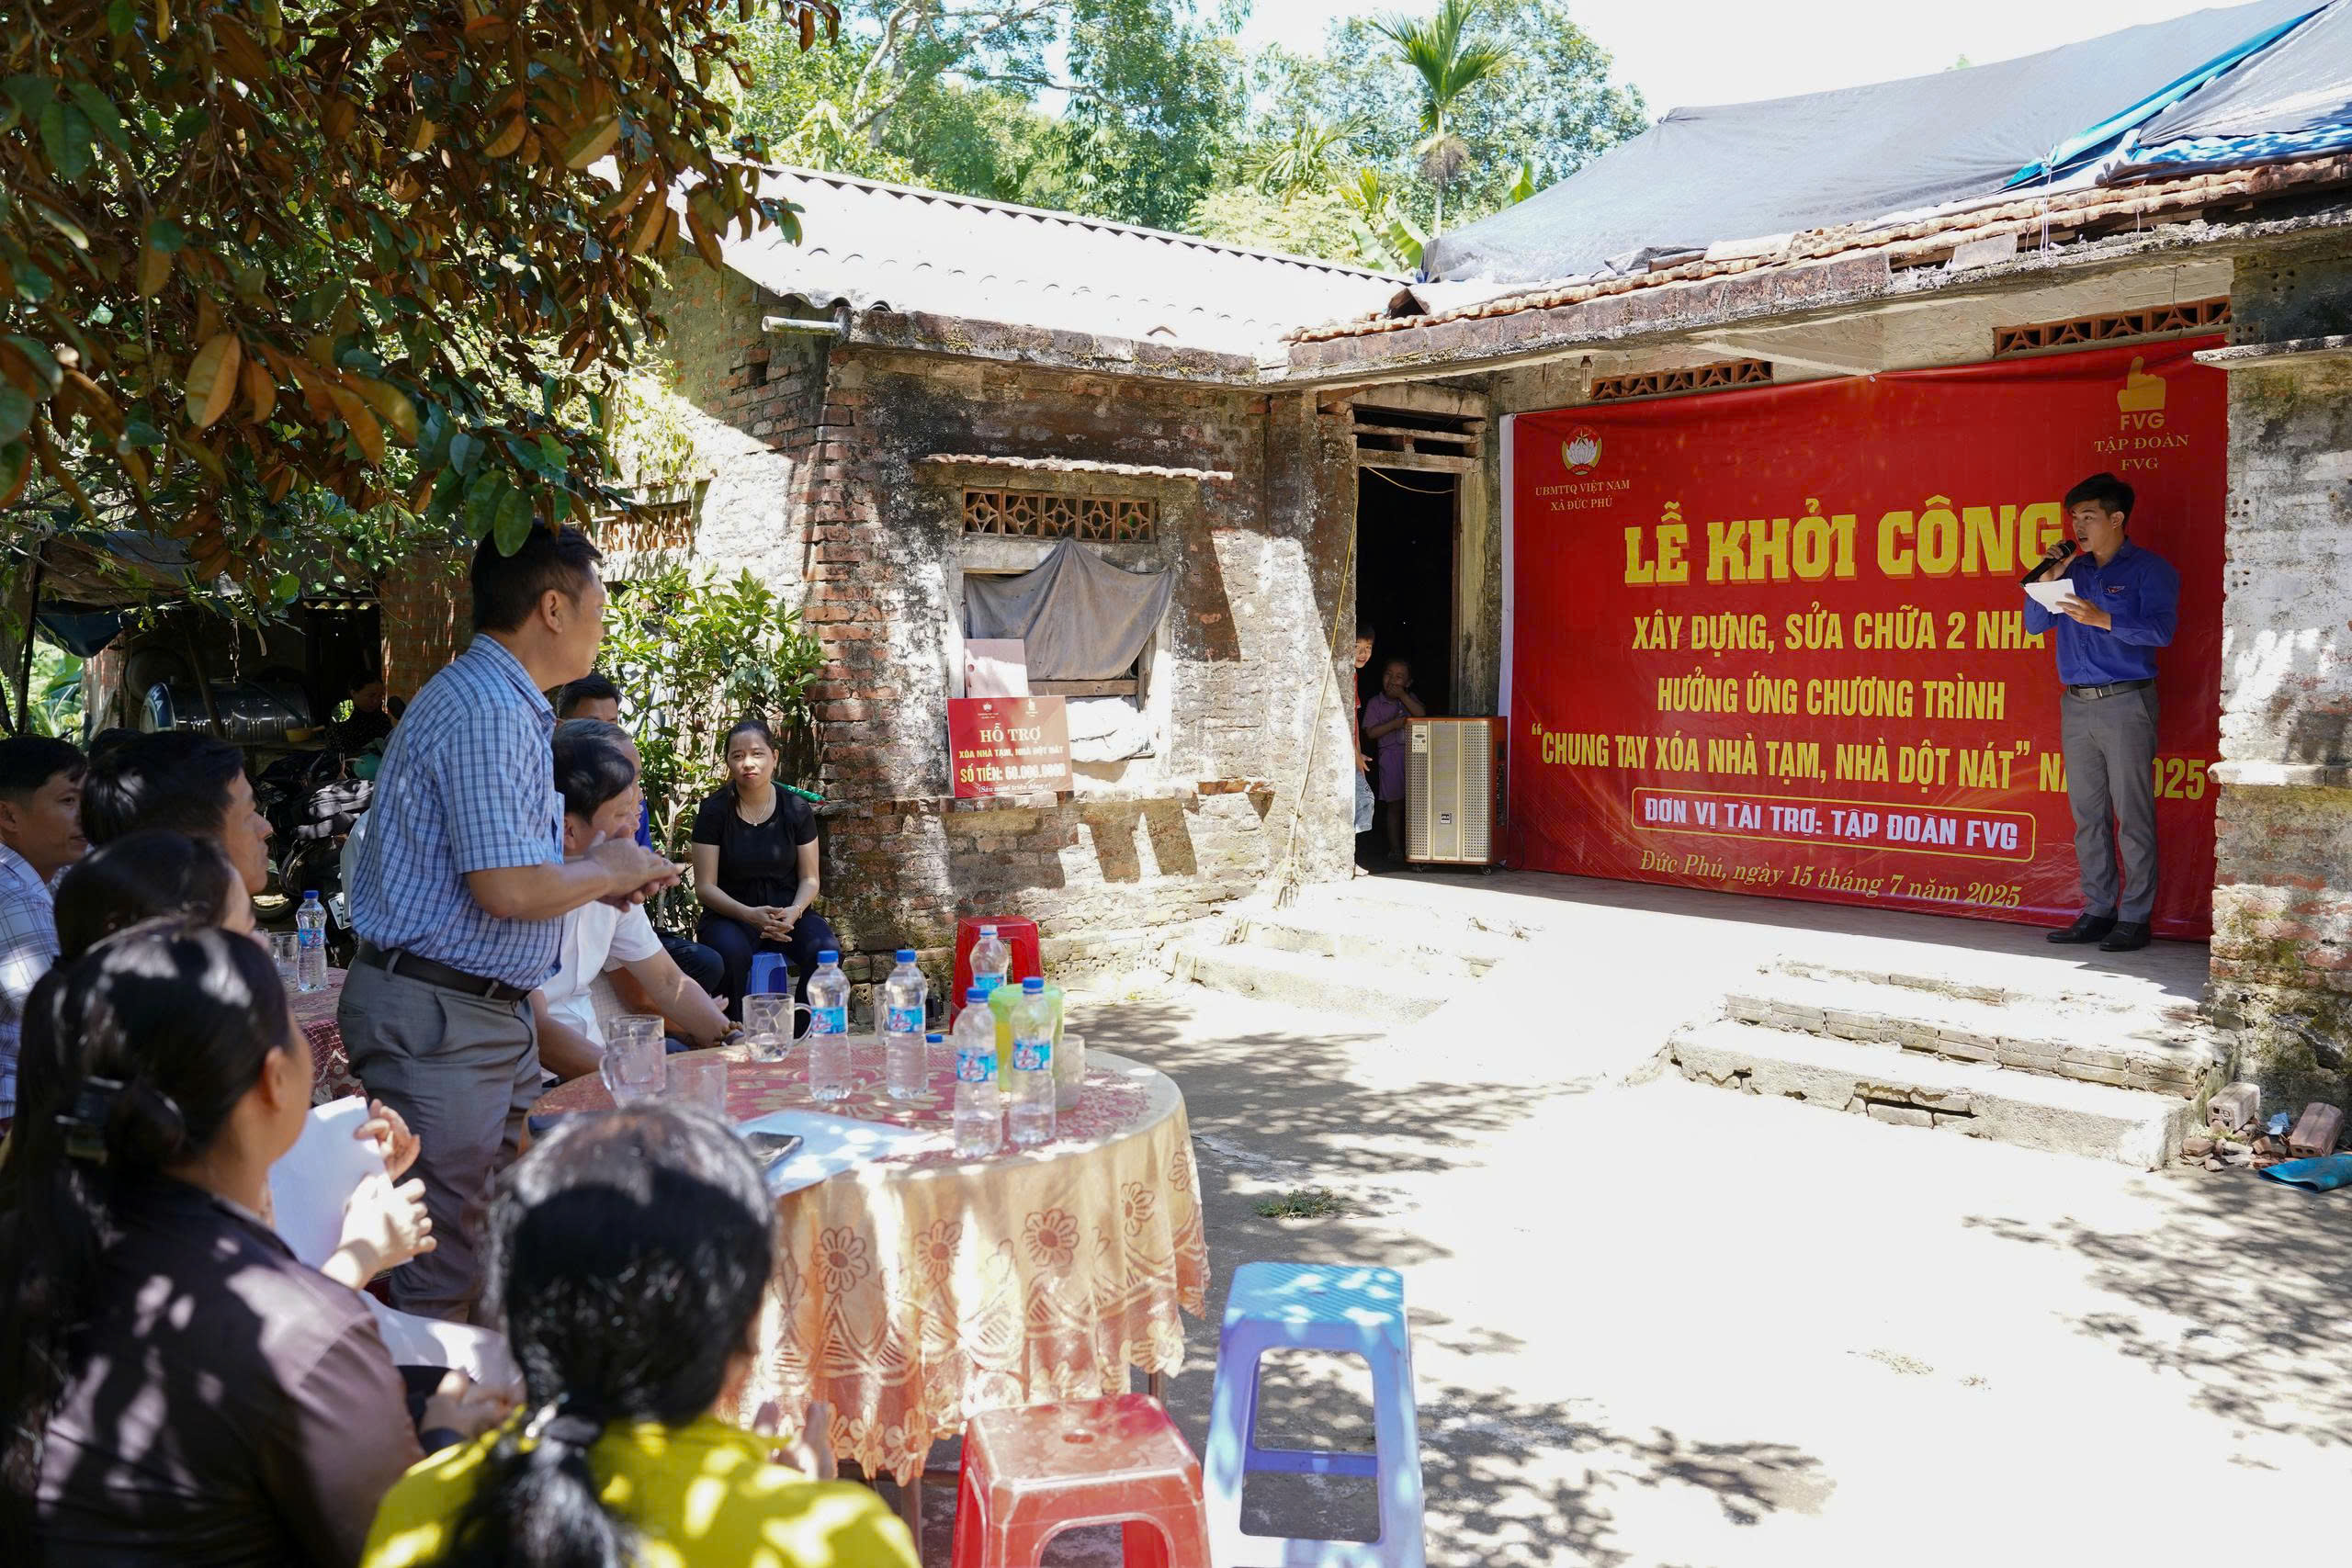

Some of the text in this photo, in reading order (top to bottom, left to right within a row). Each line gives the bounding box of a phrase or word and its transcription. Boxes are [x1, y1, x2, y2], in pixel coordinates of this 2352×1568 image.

[2120, 412, 2165, 431] FVG
[2095, 432, 2190, 454] TẬP ĐOÀN
[2120, 457, 2160, 471] FVG
[1535, 479, 1631, 496] UBMTTQ VIỆT NAM
[1567, 497, 1589, 510] ĐỨC
[1590, 494, 1612, 508] PHÚ
[1624, 494, 2064, 587] LỄ KHỞI CÔNG
[1632, 608, 1683, 650] XÂY
[1690, 611, 1775, 658] DỰNG,
[1785, 601, 1845, 650] SỬA
[1854, 604, 1937, 649] CHỮA
[1946, 611, 1967, 649] 2
[1657, 666, 2006, 720] HƯỞNG ỨNG CHƯƠNG TRÌNH
[980, 723, 1040, 743] HỖ TRỢ
[959, 750, 975, 759] XÓA
[977, 749, 993, 758] NHÀ
[960, 763, 975, 784] SỐ
[1615, 735, 1648, 770] TAY
[1655, 730, 1700, 773] XÓA
[1707, 732, 1758, 775] NHÀ
[1765, 740, 1826, 785] TẠM,
[1835, 737, 1890, 783] NHÀ
[1897, 739, 1951, 794] DỘT
[2153, 757, 2206, 800] 025
[1645, 797, 2018, 851] ĐƠN VỊ TÀI TRỢ: TẬP ĐOÀN FVG
[1639, 850, 2022, 909] Đức Phú, ngày 15 tháng 7 năm 2025
